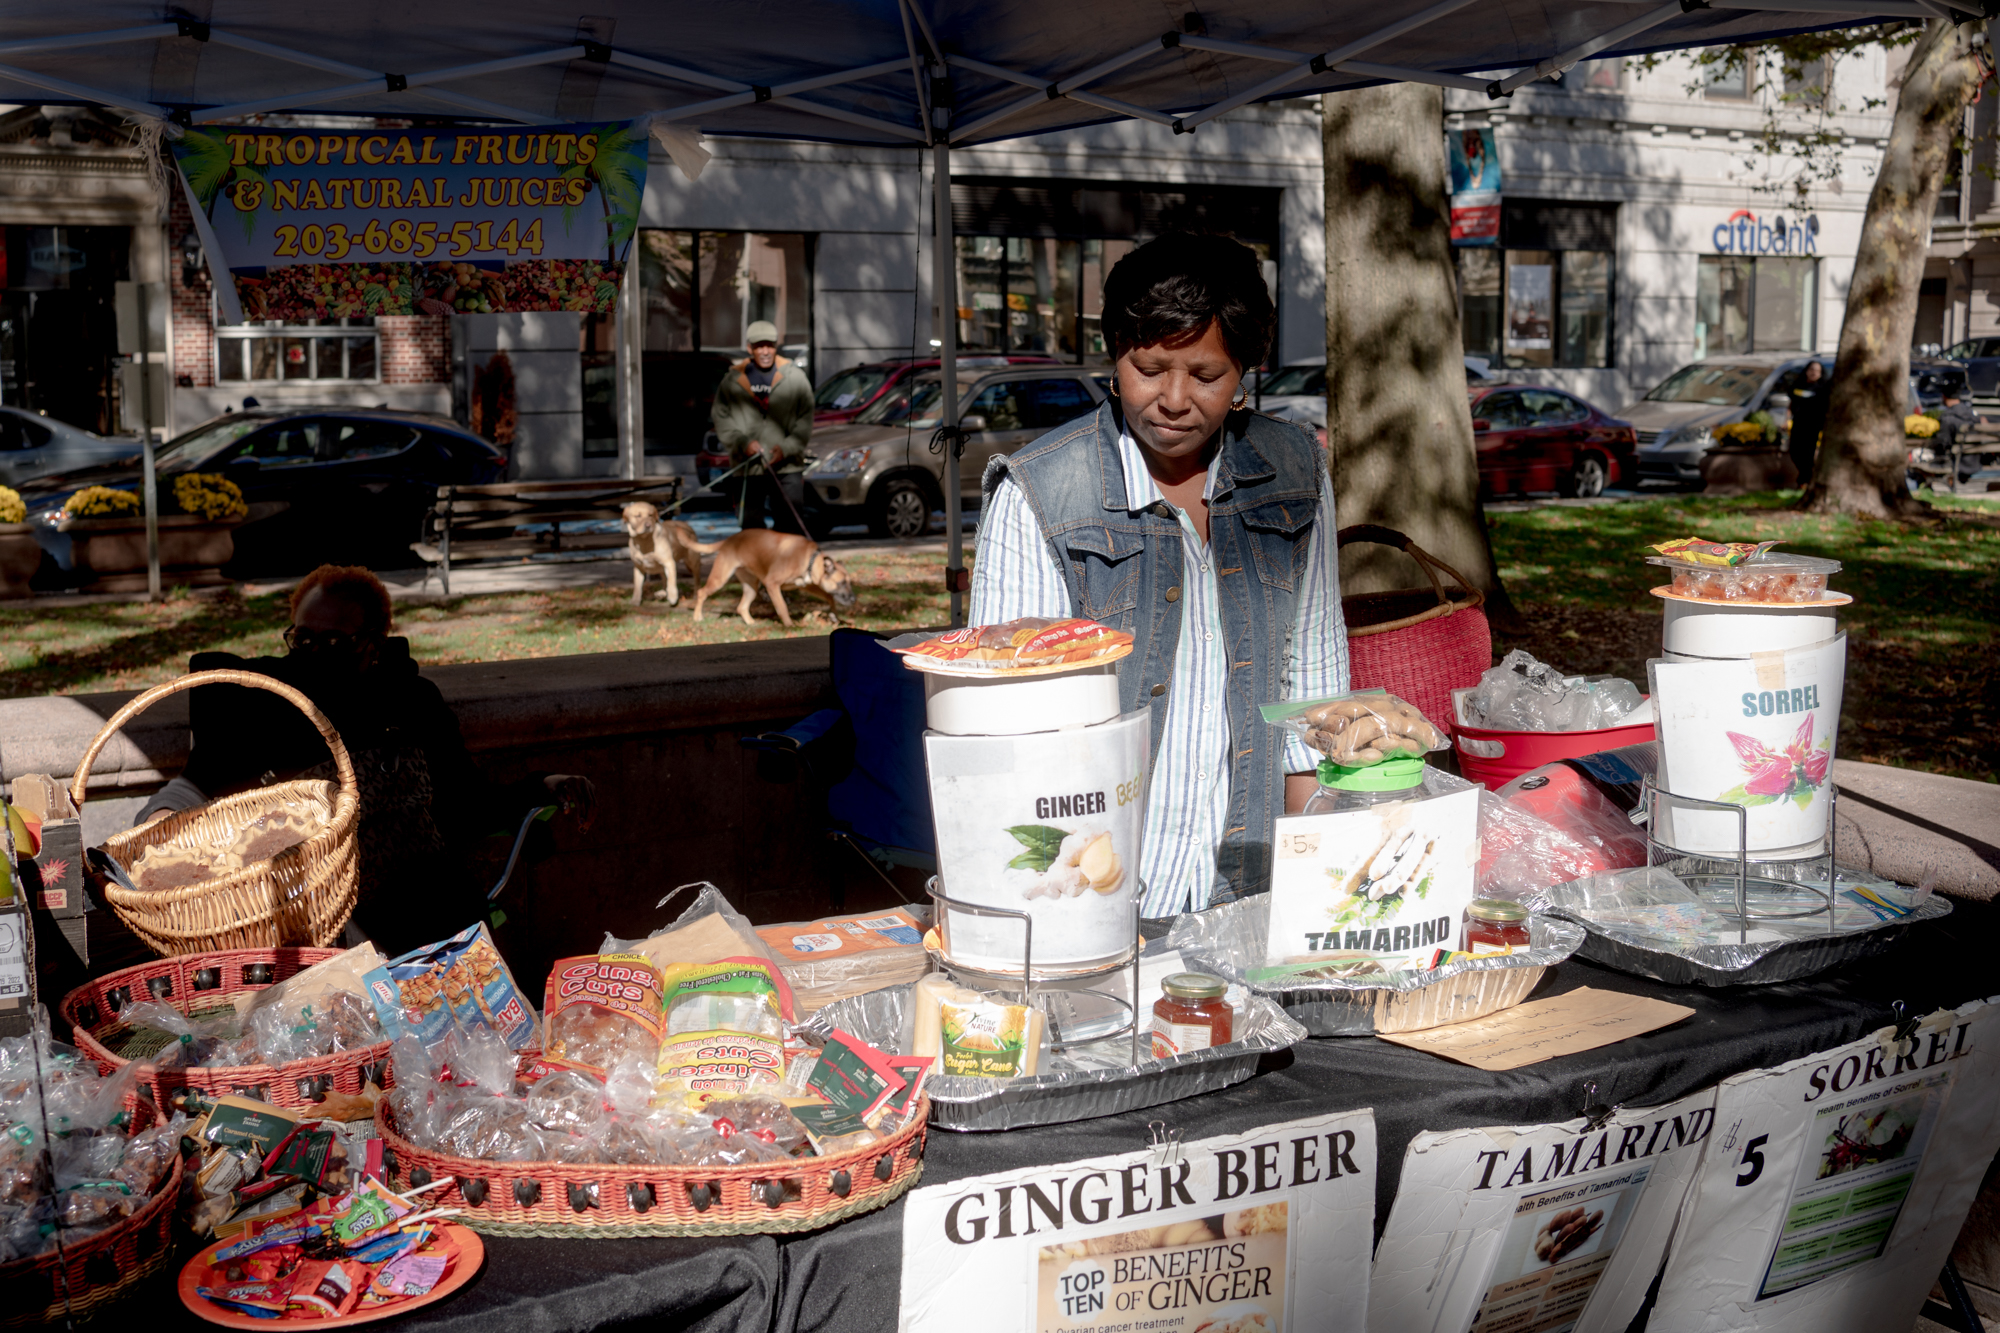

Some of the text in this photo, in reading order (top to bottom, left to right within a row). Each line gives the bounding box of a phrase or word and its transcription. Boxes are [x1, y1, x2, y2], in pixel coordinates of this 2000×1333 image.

[226, 132, 599, 166] TROPICAL FRUITS
[232, 177, 586, 211] & NATURAL JUICES
[273, 217, 544, 260] 203-685-5144
[1712, 211, 1819, 253] citibank
[1741, 684, 1820, 717] SORREL
[1035, 791, 1106, 819] GINGER
[1304, 915, 1450, 953] TAMARIND
[487, 982, 508, 1007] ORIGINA
[560, 978, 644, 1002] Cuts
[561, 962, 664, 1002] Ginge
[678, 972, 732, 990] Cholesterol Free
[971, 1023, 996, 1034] NATURE
[661, 1063, 781, 1085] Ginger
[697, 1046, 781, 1069] Cuts
[945, 1053, 979, 1074] Sugar
[981, 1058, 1013, 1072] Cane
[1804, 1021, 1974, 1102] SORREL
[690, 1078, 748, 1094] Lemon
[1816, 1079, 1922, 1117] Health Benefits of Sorrel
[223, 1127, 271, 1143] Caramel Cashew
[1473, 1107, 1716, 1191] TAMARIND
[1735, 1132, 1769, 1187] 5
[944, 1129, 1361, 1246] GINGER BEER
[1537, 1188, 1576, 1209] Benefits
[1577, 1185, 1589, 1197] of
[1590, 1173, 1632, 1195] Tamarind
[352, 1214, 376, 1236] JOLLY
[1060, 1242, 1246, 1295] TOP BENEFITS
[1063, 1266, 1272, 1316] TEN OF GINGER
[1098, 1322, 1133, 1333] cancer
[1135, 1316, 1185, 1329] treatment
